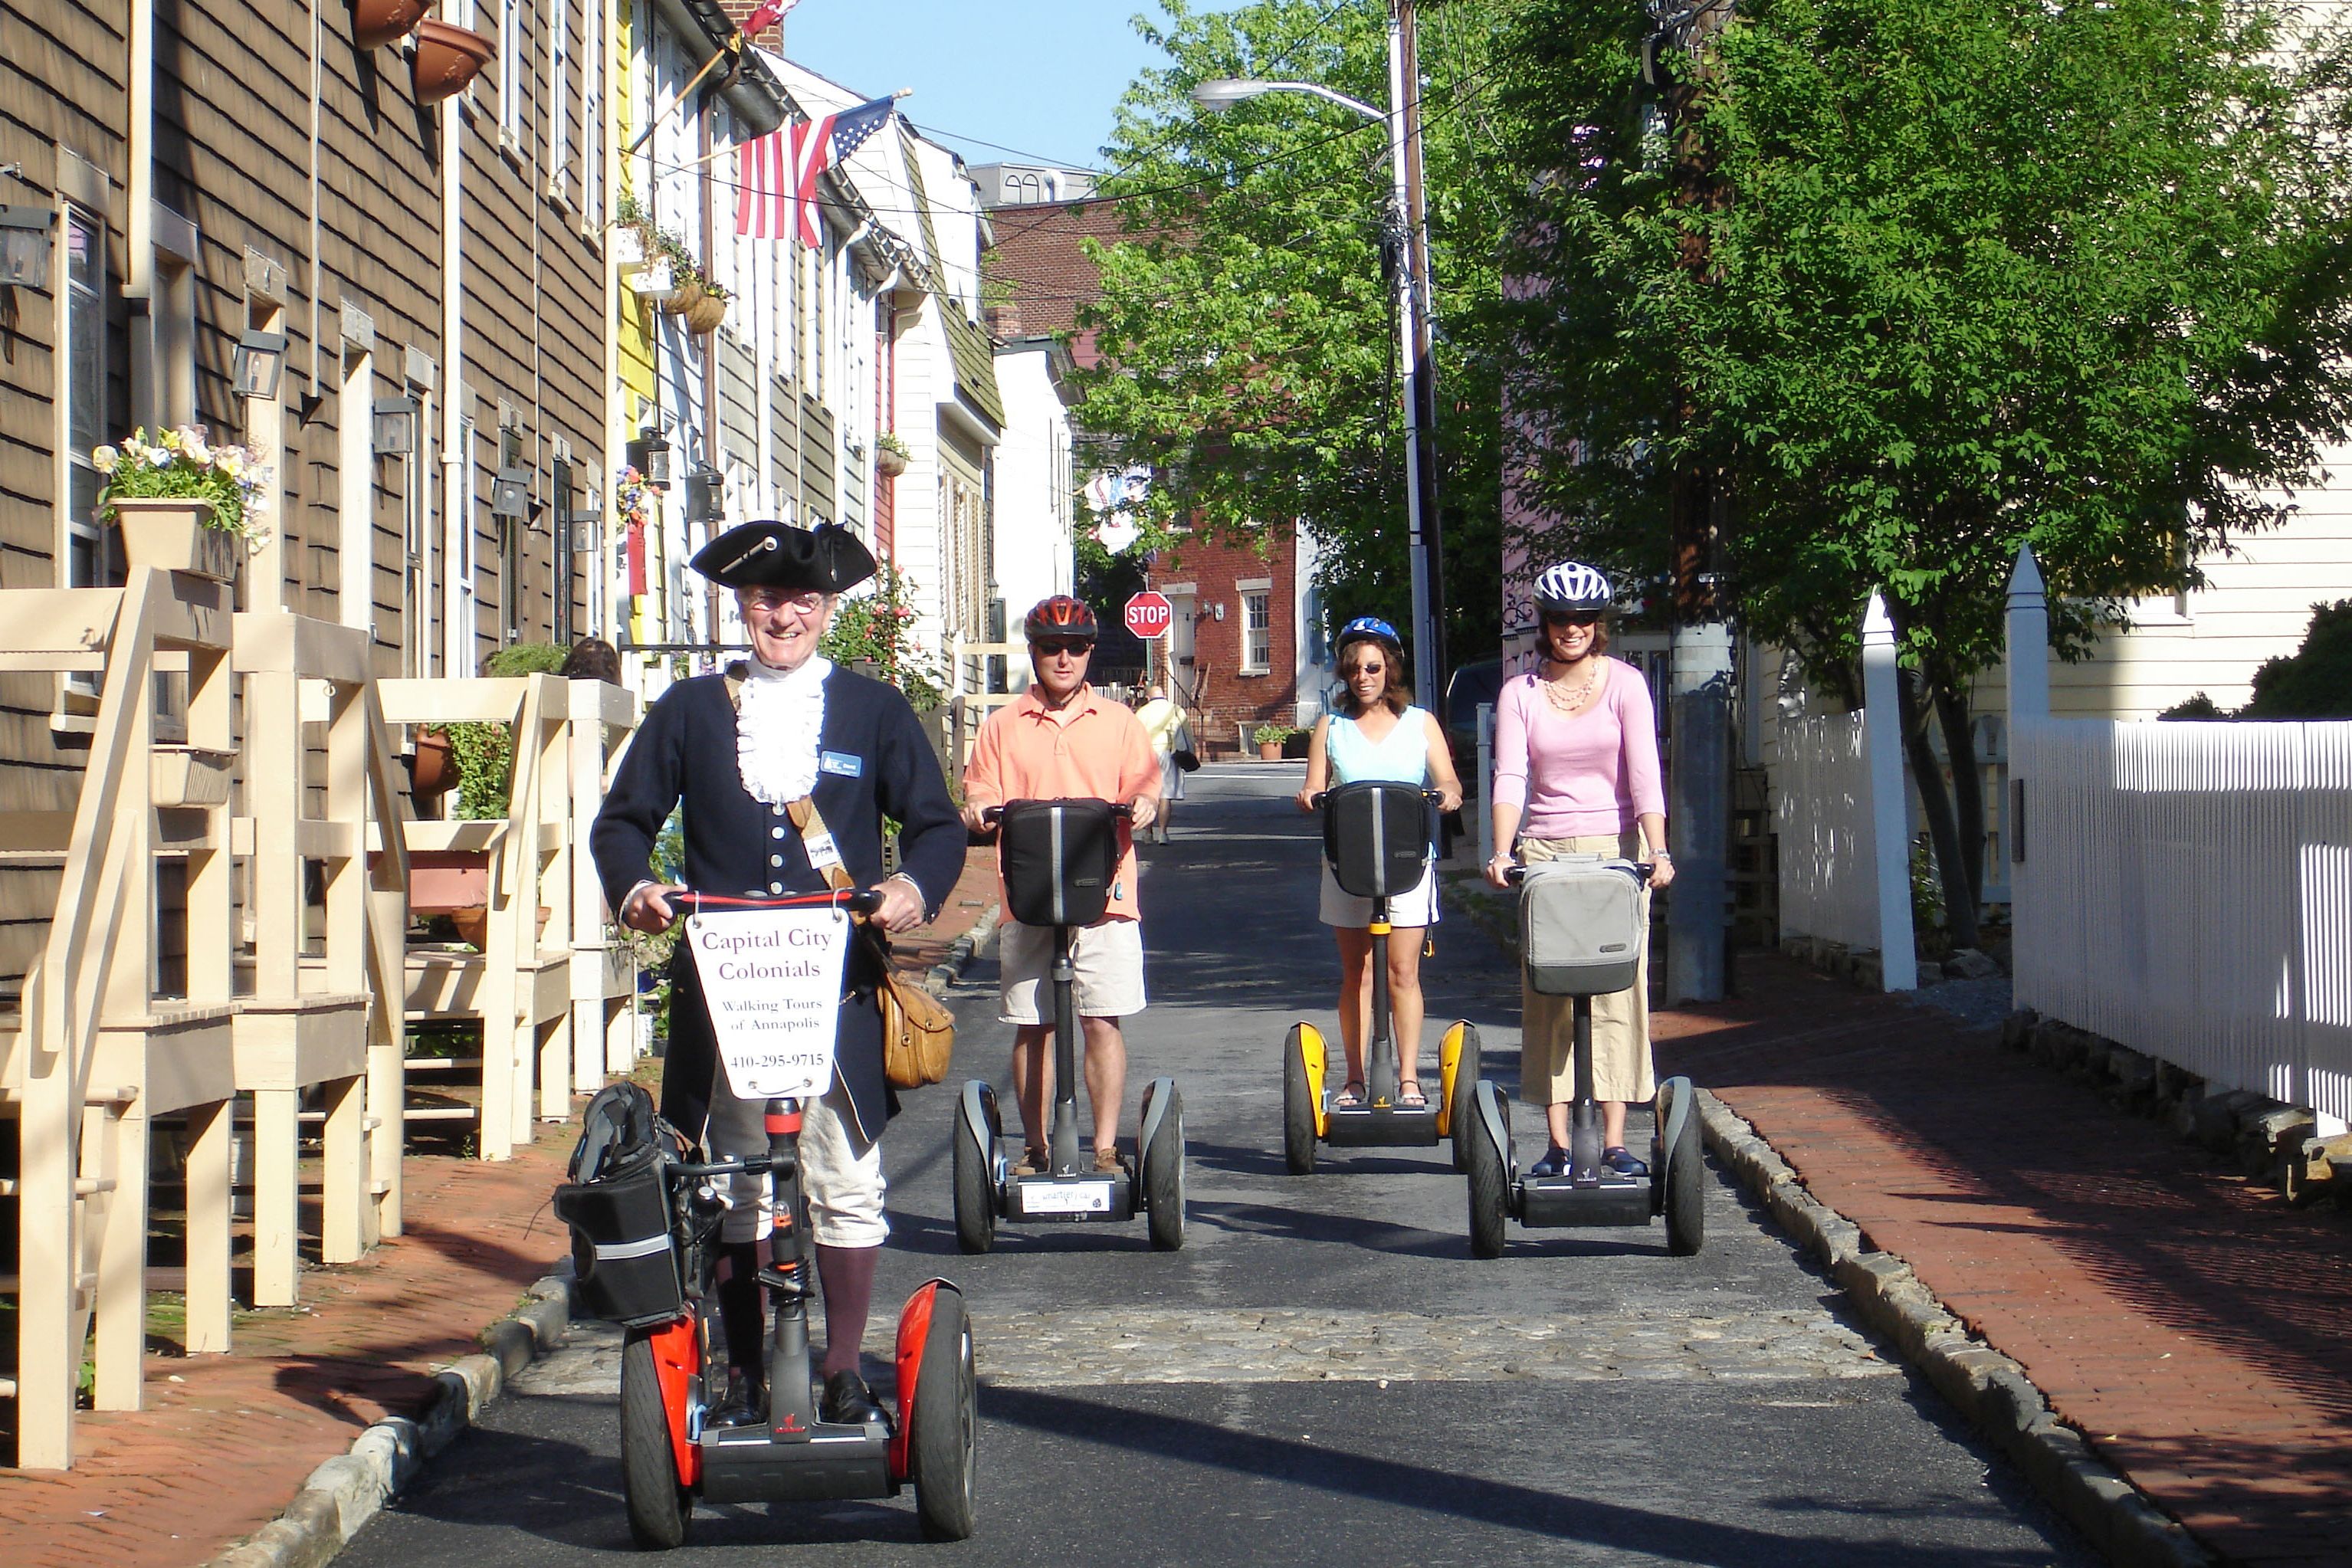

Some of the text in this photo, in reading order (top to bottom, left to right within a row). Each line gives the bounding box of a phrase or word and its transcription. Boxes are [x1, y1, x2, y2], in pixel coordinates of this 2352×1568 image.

[1128, 605, 1168, 624] STOP
[703, 929, 832, 954] Capital City
[719, 960, 821, 980] Colonials
[722, 999, 822, 1012] Walking Tours
[730, 1017, 819, 1032] of Annapolis
[730, 1053, 824, 1068] 410-295-9715
